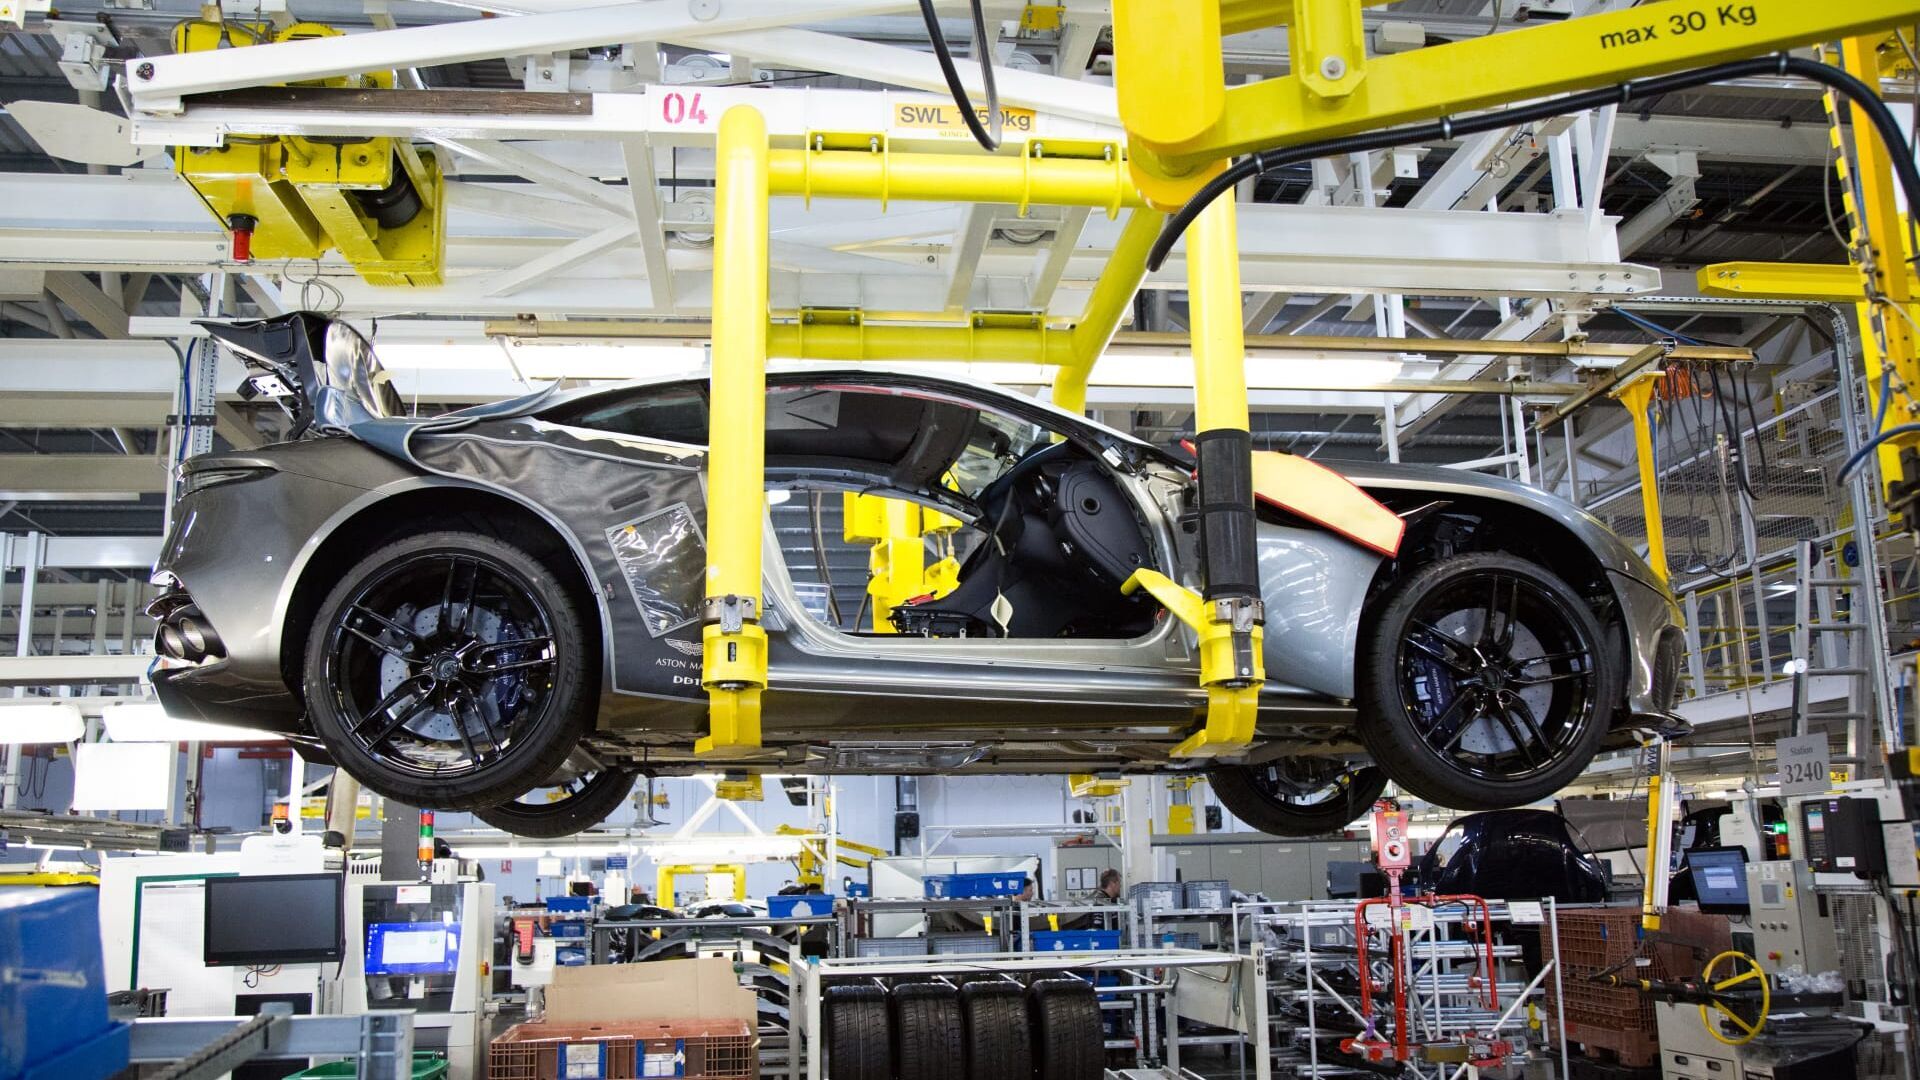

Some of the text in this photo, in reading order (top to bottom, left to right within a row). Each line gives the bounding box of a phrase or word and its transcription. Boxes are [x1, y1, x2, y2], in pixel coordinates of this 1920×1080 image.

[1600, 4, 1757, 49] max 30 Kg
[663, 92, 709, 124] 04
[900, 106, 949, 124] SWL
[655, 658, 687, 668] ASTON
[1784, 761, 1823, 784] 3240
